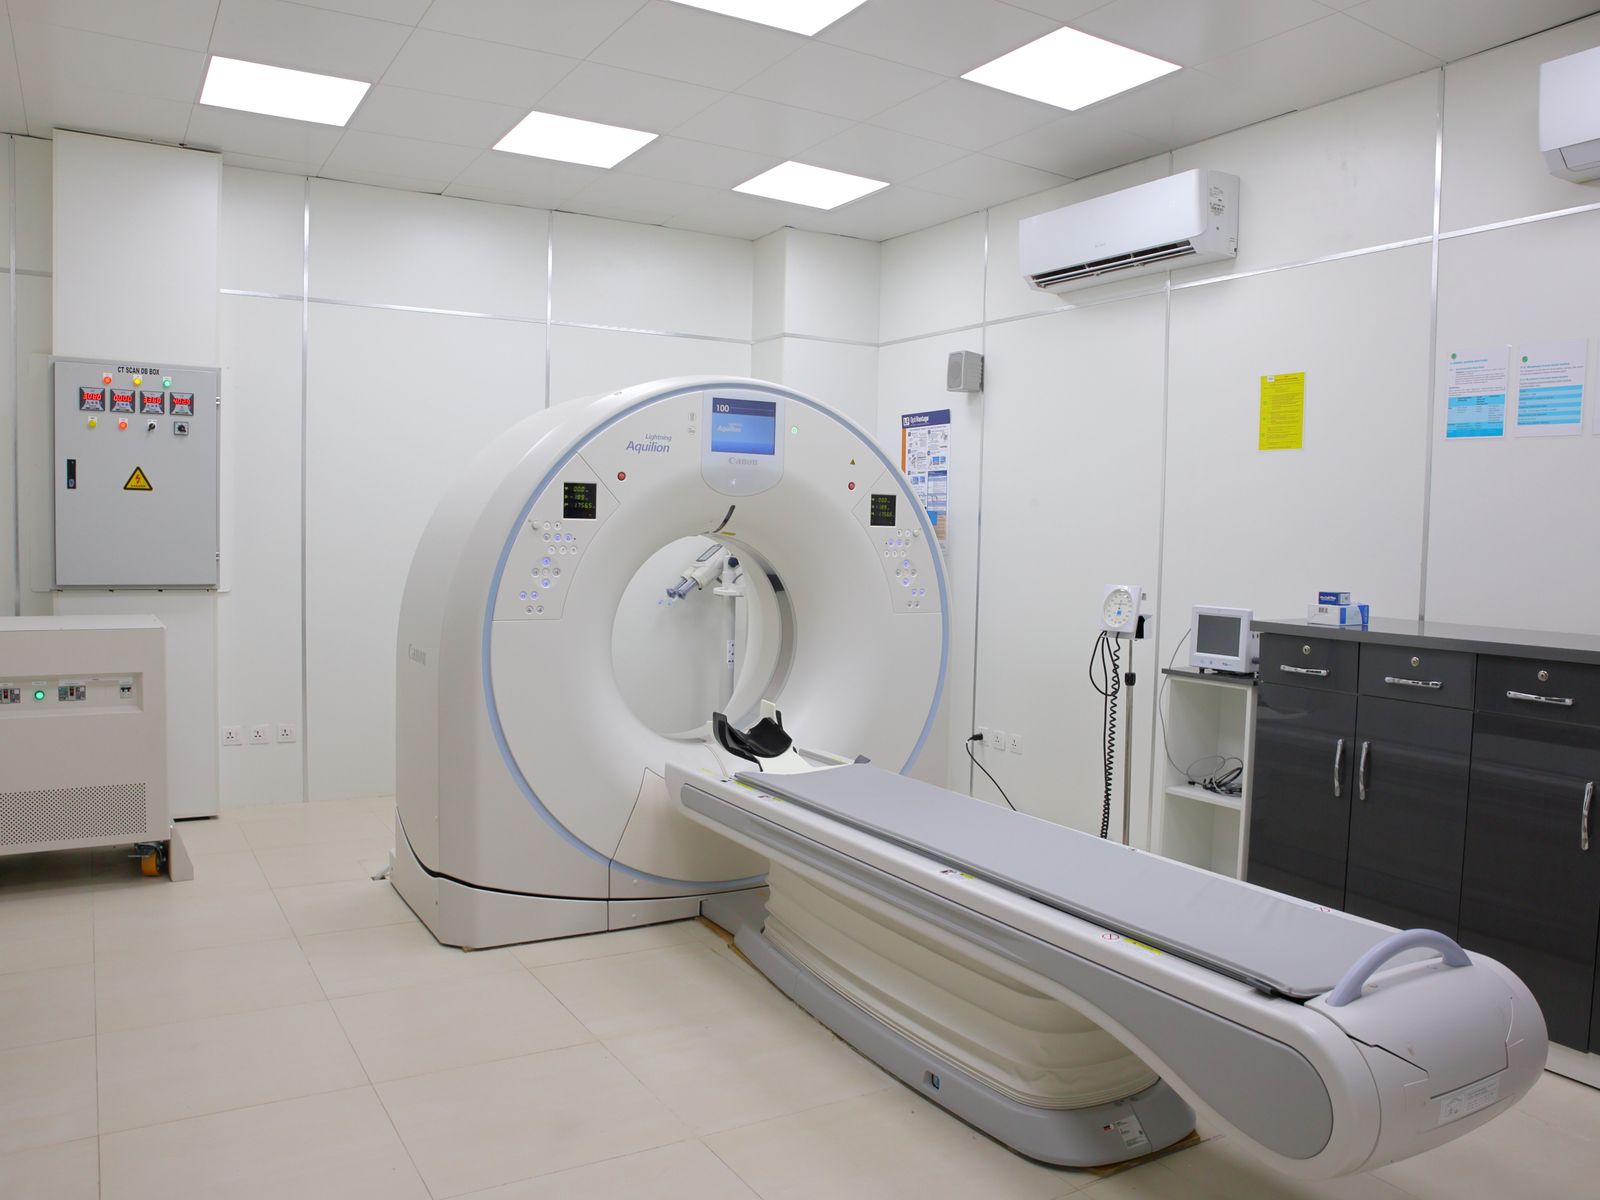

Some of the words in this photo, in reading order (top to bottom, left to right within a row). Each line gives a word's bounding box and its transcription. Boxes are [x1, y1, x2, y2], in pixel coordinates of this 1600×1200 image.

[125, 366, 140, 374] SCAN
[716, 404, 730, 413] 100
[645, 433, 672, 442] Lightning
[625, 440, 670, 454] Aquilion
[728, 457, 758, 466] Canon
